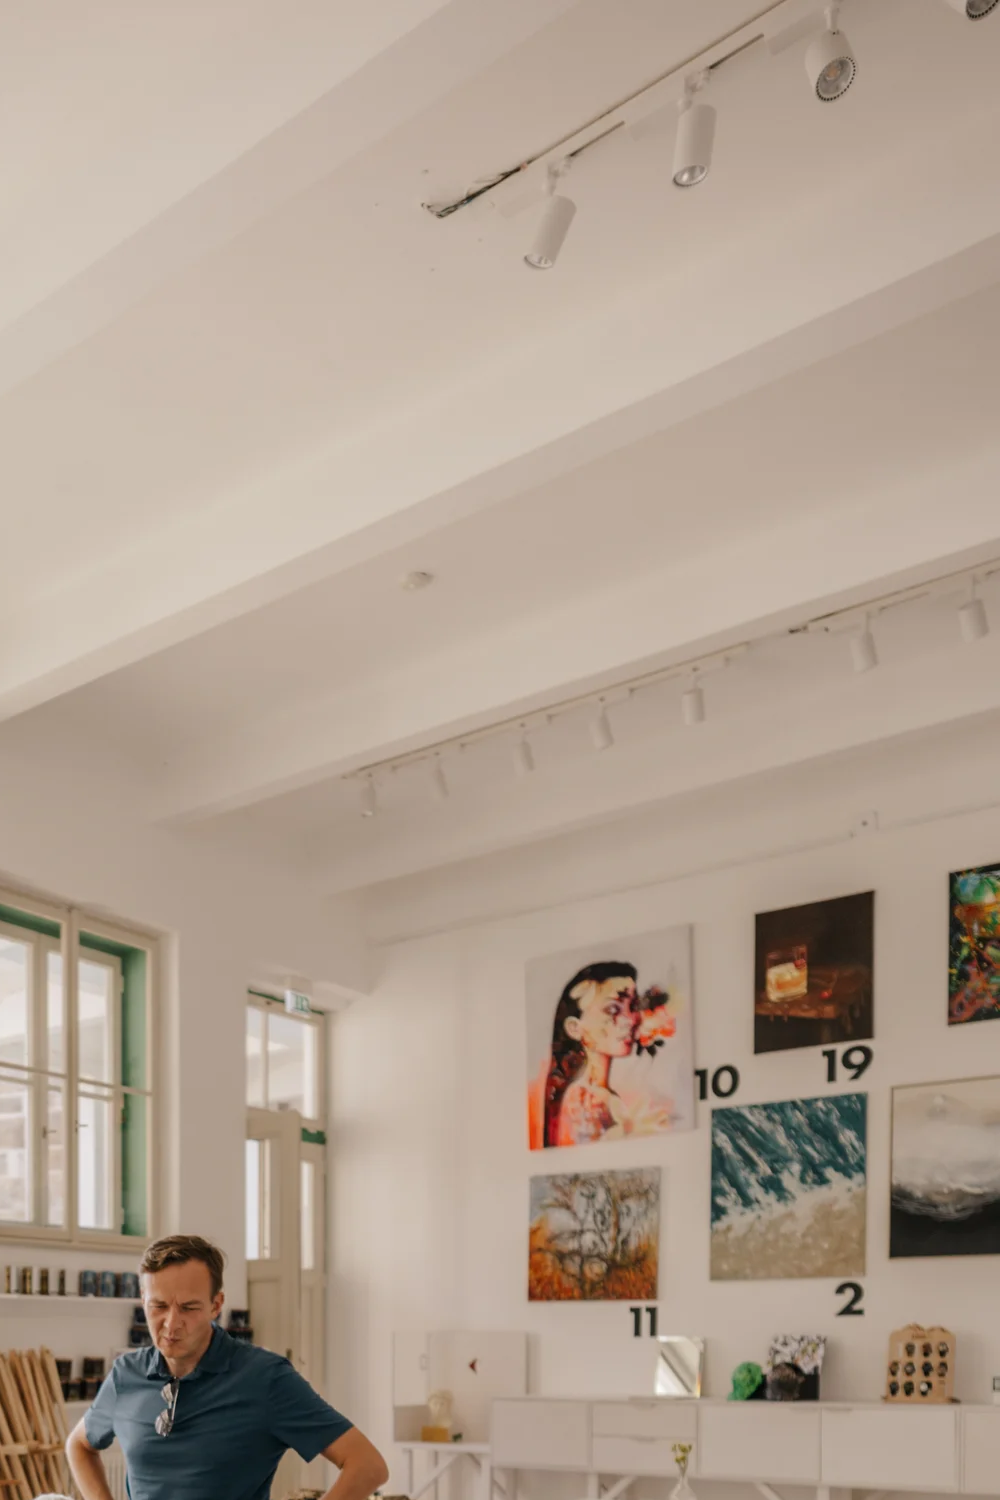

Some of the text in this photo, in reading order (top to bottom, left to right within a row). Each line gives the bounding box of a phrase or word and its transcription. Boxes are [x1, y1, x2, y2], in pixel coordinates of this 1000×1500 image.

[821, 1044, 874, 1083] 19
[693, 1064, 740, 1101] 10
[835, 1281, 865, 1317] 2
[629, 1306, 658, 1338] 11
